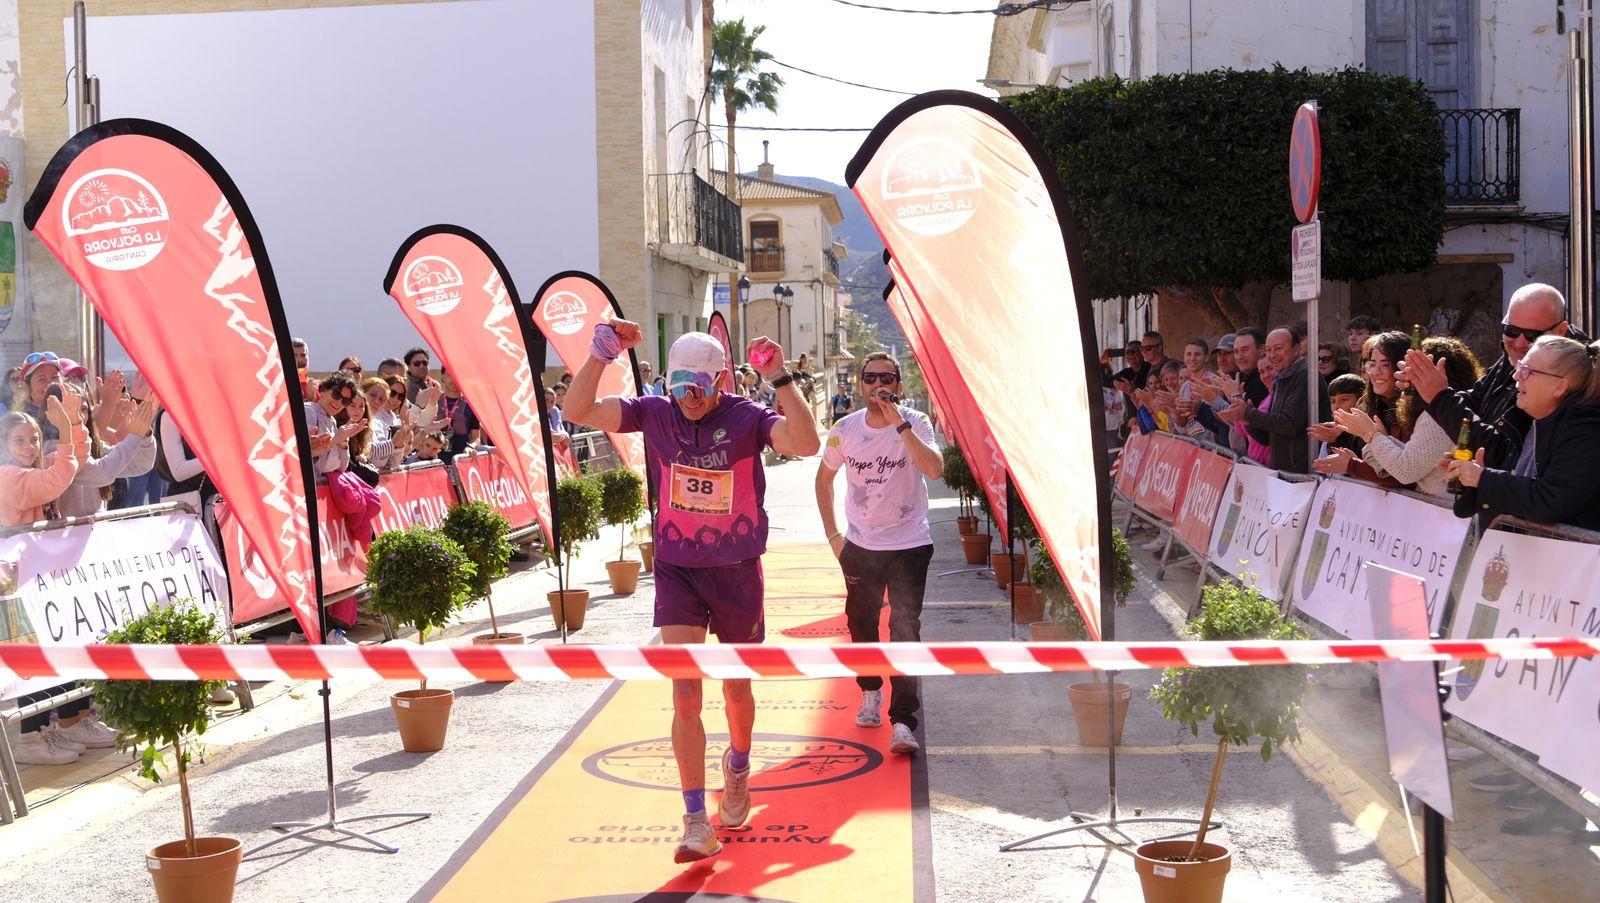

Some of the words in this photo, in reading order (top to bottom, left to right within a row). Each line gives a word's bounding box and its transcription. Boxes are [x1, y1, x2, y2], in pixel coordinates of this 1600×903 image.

[485, 477, 528, 509] VEOLIA
[686, 478, 714, 495] 38
[36, 550, 176, 592] AYUNTAMIENTO
[181, 544, 205, 565] DE
[1429, 551, 1447, 578] DE
[568, 834, 829, 845] Ayuntmiento
[765, 824, 809, 833] de
